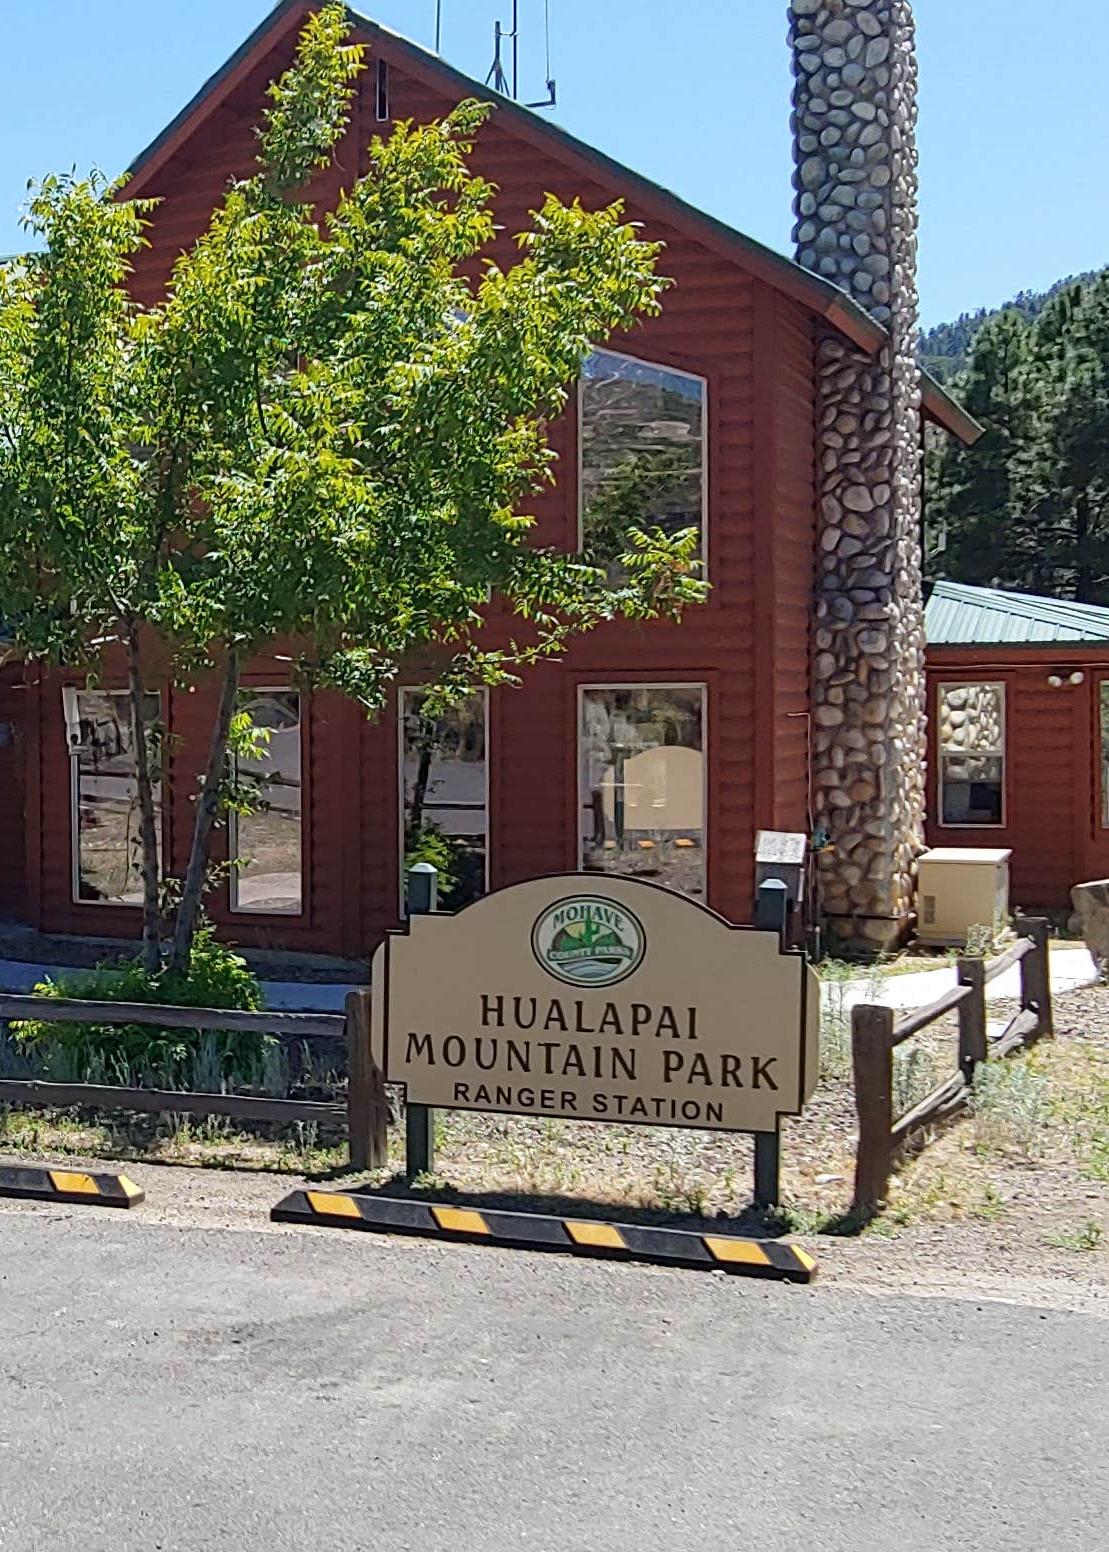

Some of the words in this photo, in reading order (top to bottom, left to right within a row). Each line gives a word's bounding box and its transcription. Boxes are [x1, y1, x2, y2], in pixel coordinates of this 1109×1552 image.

[553, 905, 626, 932] MOHAVE
[480, 994, 699, 1040] HUALAPAI
[405, 1033, 638, 1080] MOUNTAIN
[663, 1050, 780, 1091] PARK
[453, 1082, 578, 1111] RANGER
[593, 1093, 723, 1123] STATION
